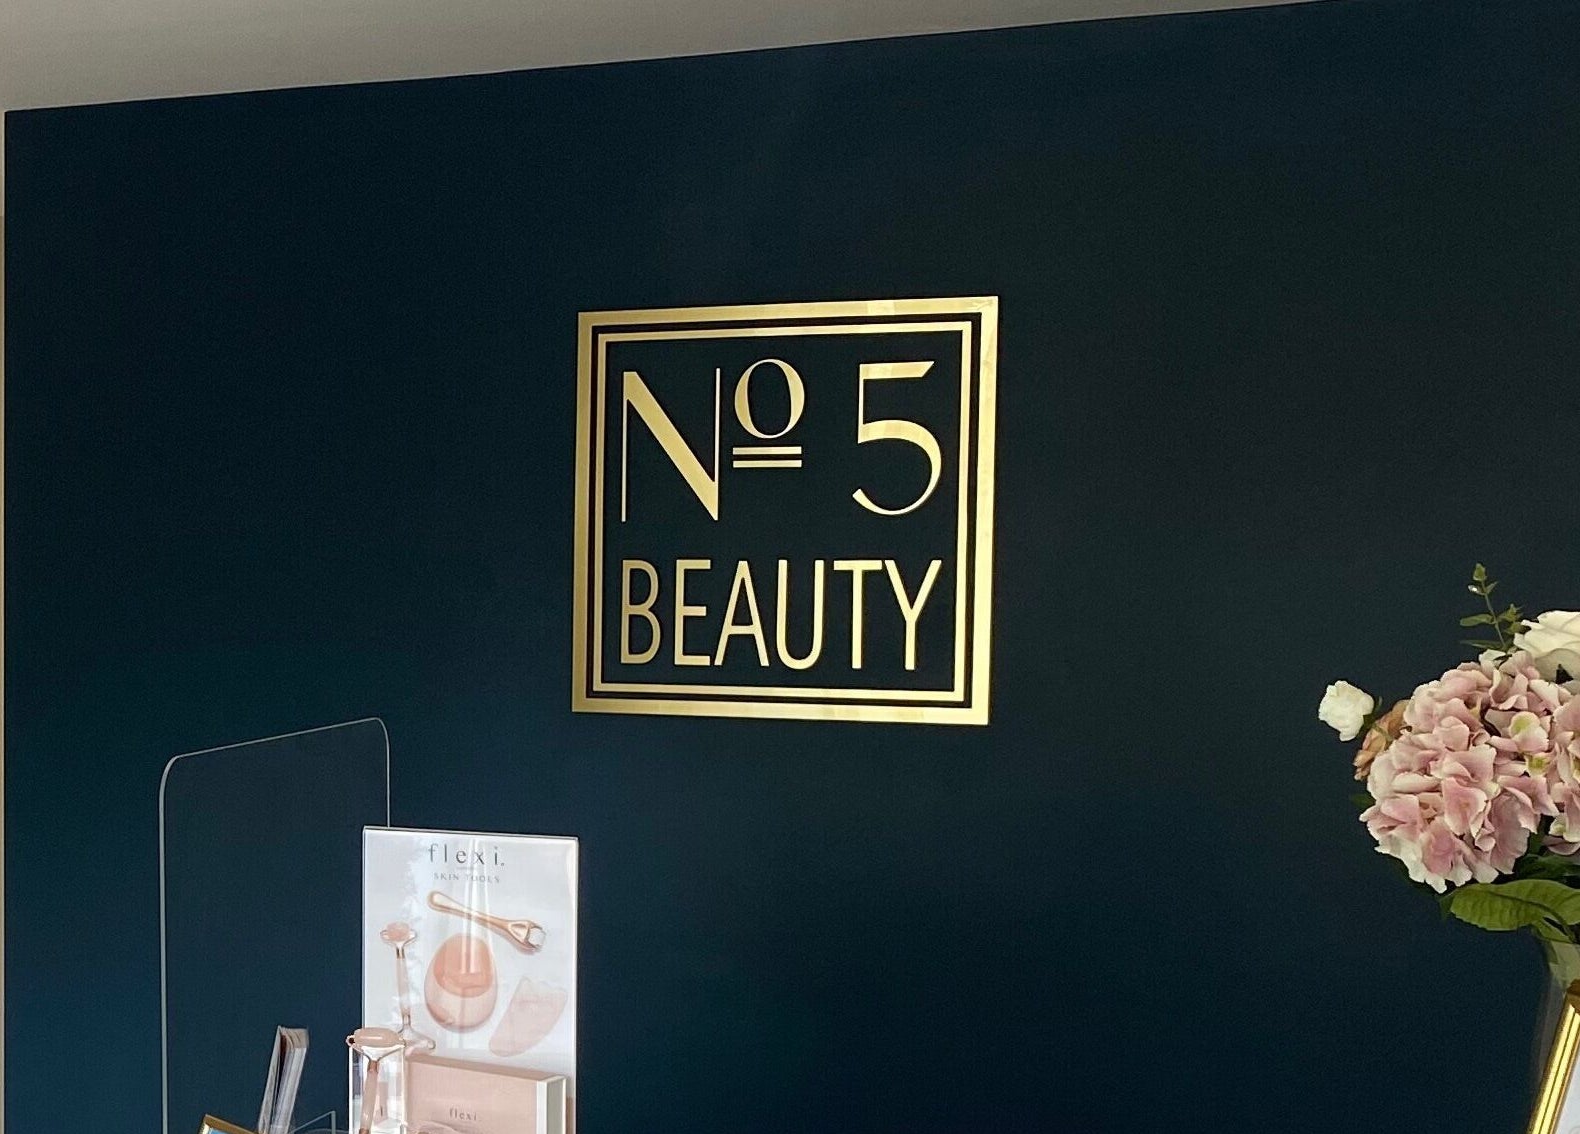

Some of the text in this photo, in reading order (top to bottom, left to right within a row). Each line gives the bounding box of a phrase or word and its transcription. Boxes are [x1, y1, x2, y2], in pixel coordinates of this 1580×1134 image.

[852, 360, 942, 516] 5
[620, 558, 942, 671] BEAUTY
[433, 872, 501, 884] SKIN TOOLS
